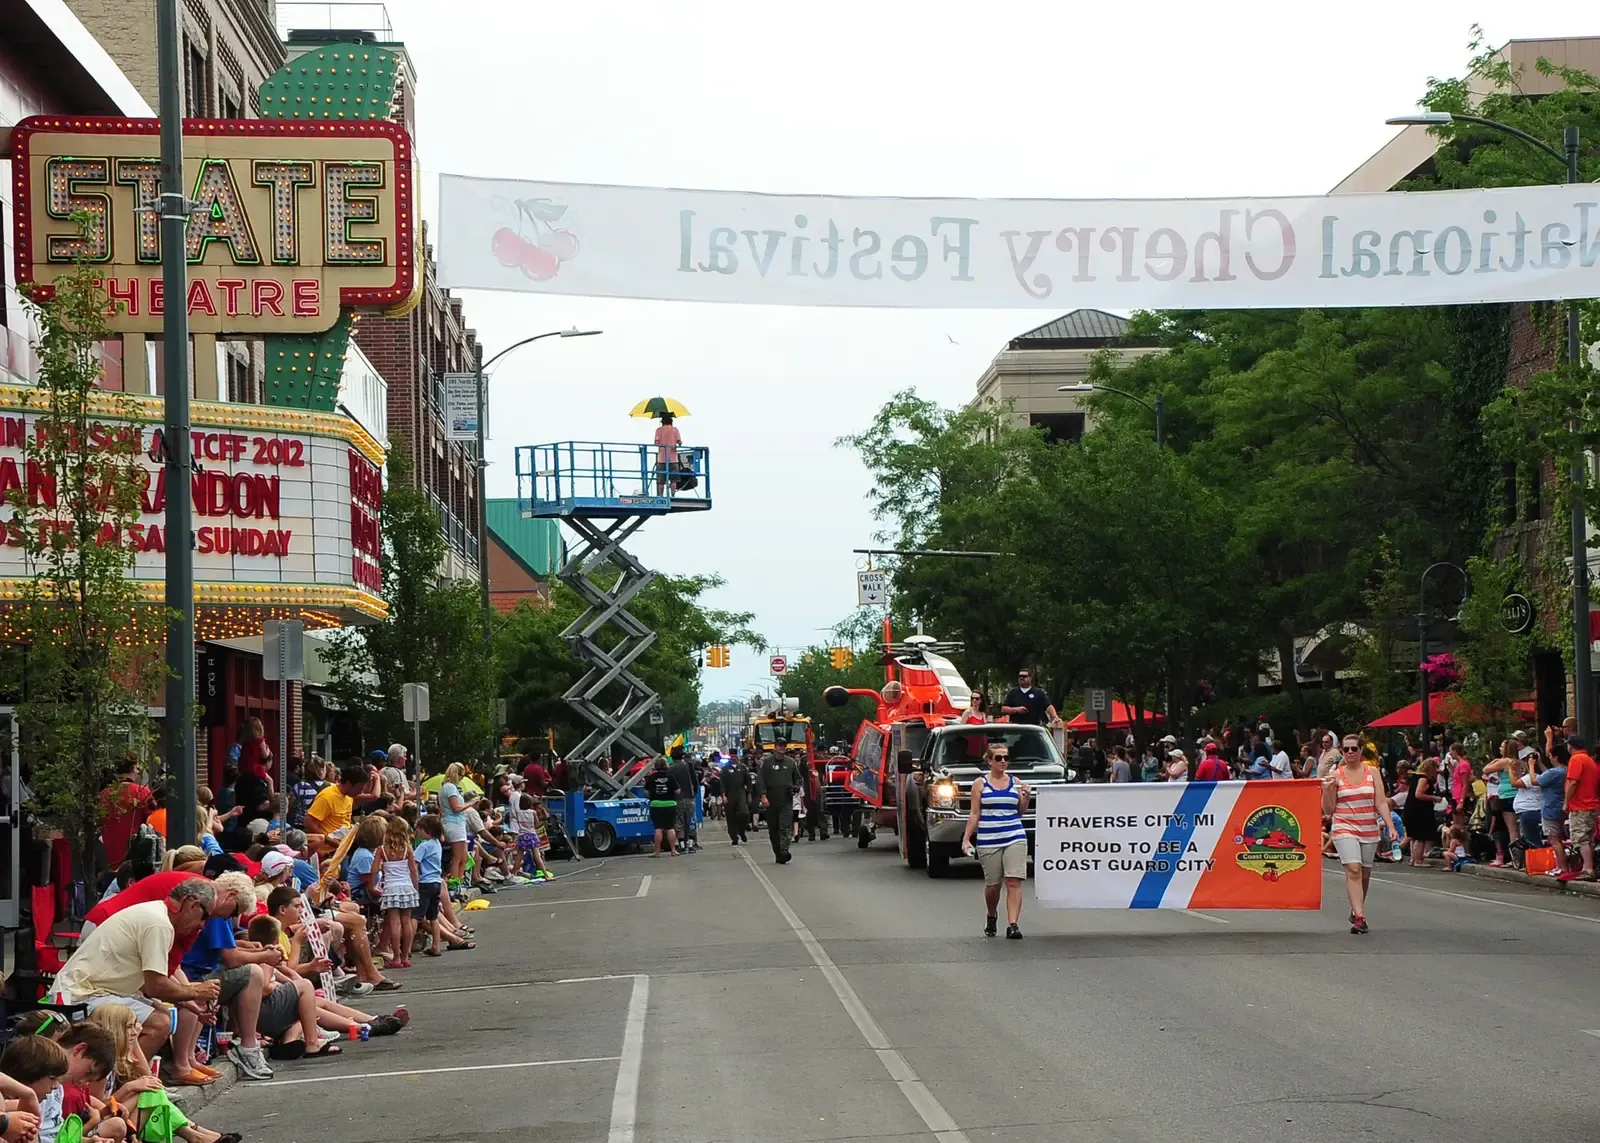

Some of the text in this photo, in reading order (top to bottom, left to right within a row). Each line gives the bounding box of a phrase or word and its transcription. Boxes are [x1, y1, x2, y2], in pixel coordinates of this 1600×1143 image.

[45, 156, 386, 264] STATE
[80, 277, 319, 317] HEATRE
[191, 432, 248, 462] TCFF
[253, 437, 304, 468] 2012
[198, 526, 292, 557] SUNDAY
[860, 574, 884, 582] CROSS
[862, 583, 882, 591] WALK
[1046, 814, 1215, 830] TRAVERSE CITY, MI
[1247, 808, 1273, 827] Traverse
[1060, 841, 1198, 854] PROUD TO BE A
[1285, 853, 1299, 861] City
[1043, 859, 1215, 872] COAST GUARD CITY
